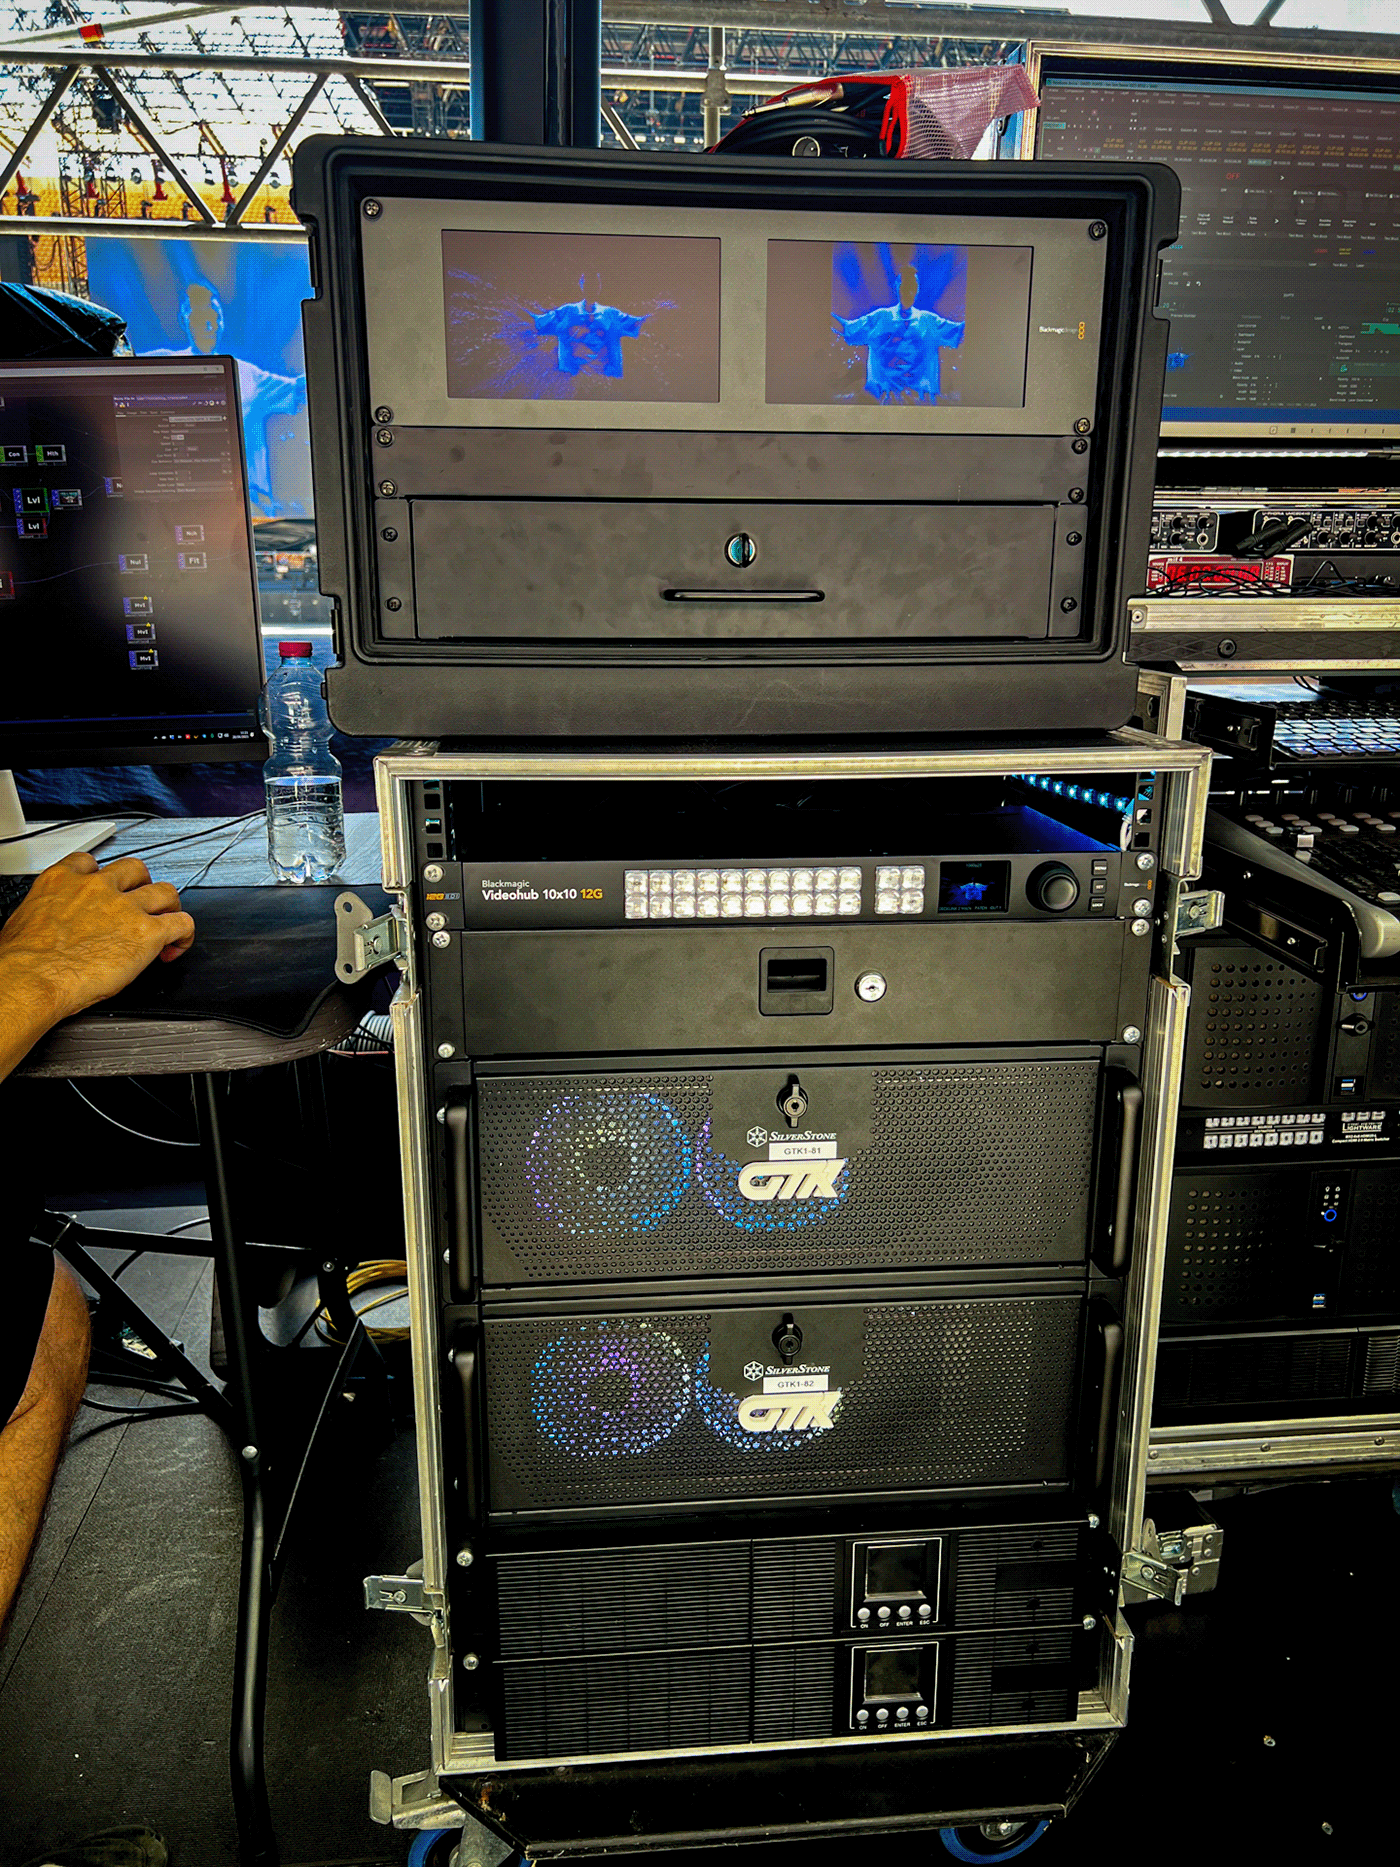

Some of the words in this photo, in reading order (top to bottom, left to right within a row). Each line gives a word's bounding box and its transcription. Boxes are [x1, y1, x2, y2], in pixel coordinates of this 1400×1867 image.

[482, 879, 530, 889] Blackmagic
[482, 889, 539, 900] Videohub
[542, 888, 578, 900] 10x10
[580, 888, 603, 900] 12G
[778, 1380, 814, 1388] GTK1-82
